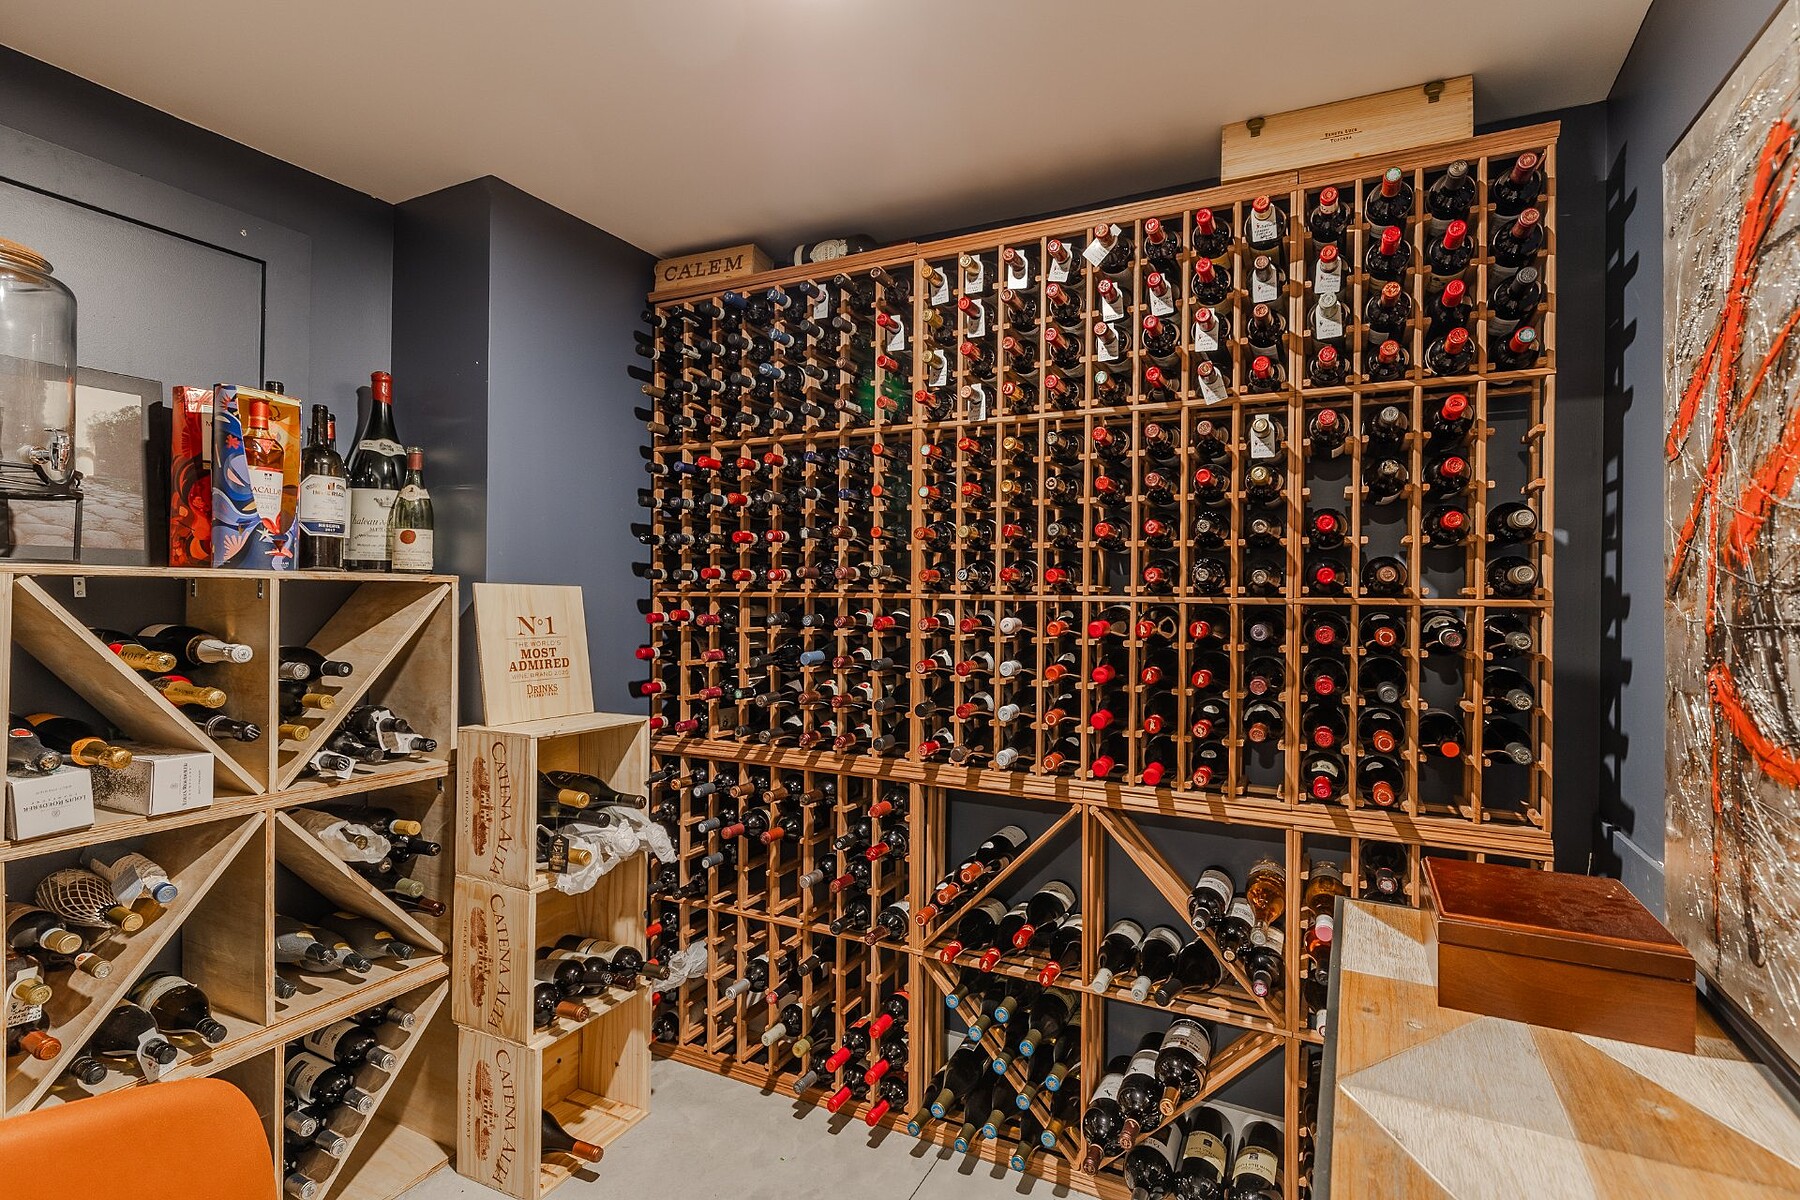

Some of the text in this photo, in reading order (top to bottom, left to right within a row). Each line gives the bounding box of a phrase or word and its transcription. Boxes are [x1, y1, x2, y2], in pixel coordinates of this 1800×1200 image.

[509, 658, 570, 672] ADMIRED
[520, 647, 557, 659] MOST
[489, 741, 512, 875] CATENA ALTA
[488, 894, 511, 1029] CATENA ALTA
[492, 1049, 517, 1187] CATENA ALTA
